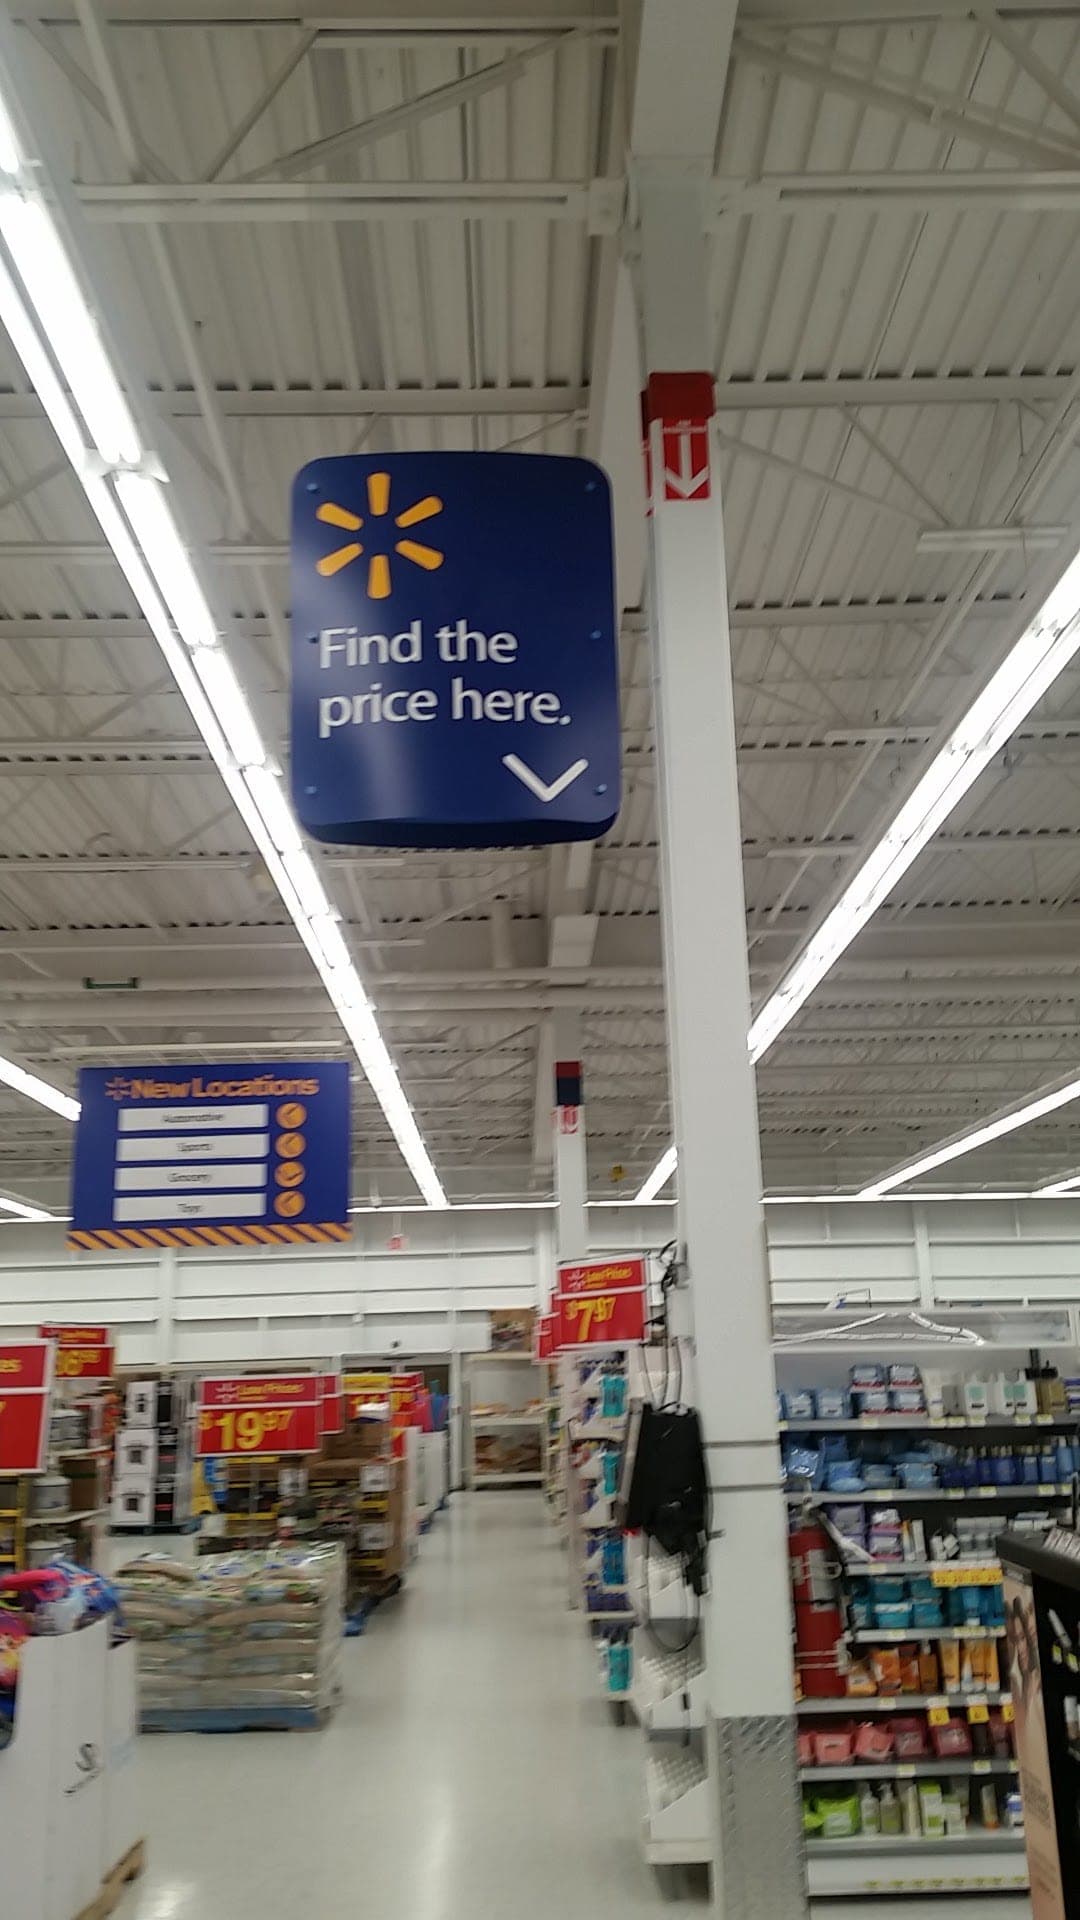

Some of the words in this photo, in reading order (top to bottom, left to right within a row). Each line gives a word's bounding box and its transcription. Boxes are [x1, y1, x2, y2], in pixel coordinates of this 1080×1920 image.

[319, 619, 422, 669] Find
[434, 618, 518, 664] the
[318, 682, 438, 739] price
[451, 676, 571, 726] here.
[131, 1079, 192, 1099] New
[191, 1073, 320, 1098] Locations
